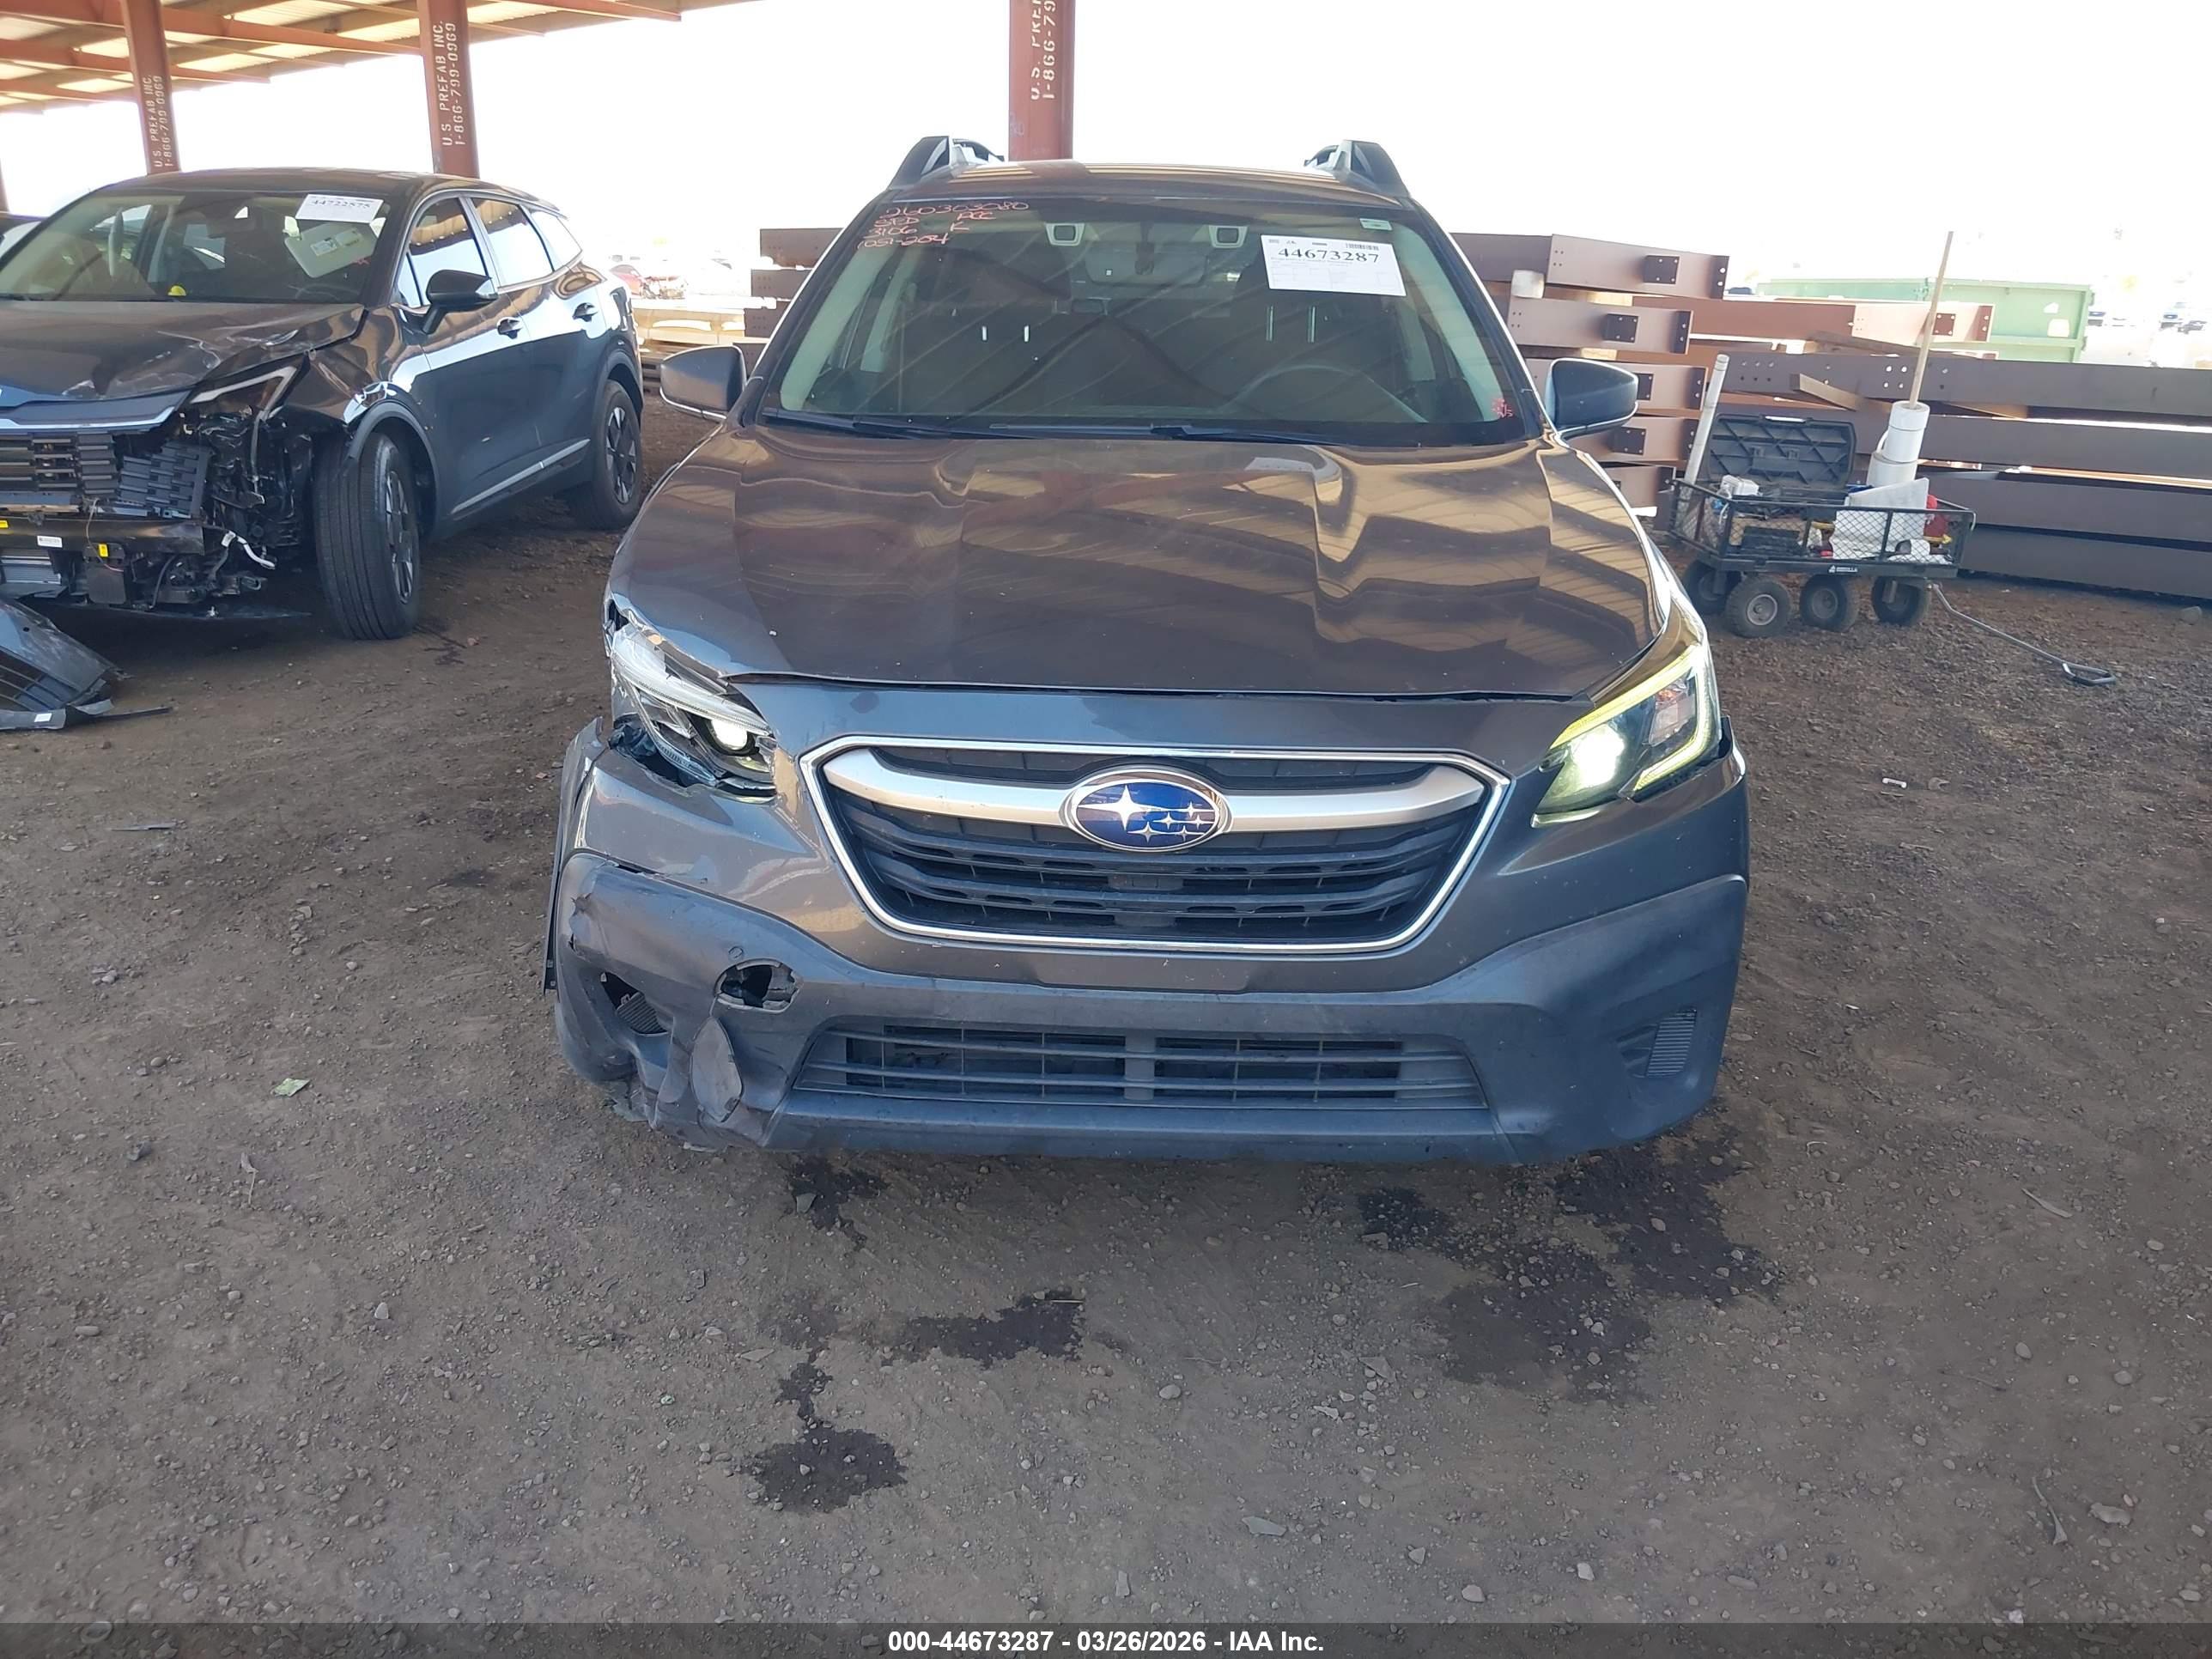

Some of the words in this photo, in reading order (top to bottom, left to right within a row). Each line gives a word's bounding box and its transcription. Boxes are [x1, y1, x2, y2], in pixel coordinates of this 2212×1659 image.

[433, 21, 446, 48] INC.
[143, 75, 154, 95] INC.
[435, 54, 451, 112] PREFAB
[445, 22, 465, 145] 1-866-799-0969
[145, 100, 160, 142] PREFAB
[153, 76, 173, 167] 1-866-799-0969
[1278, 246, 1379, 264] 44673287
